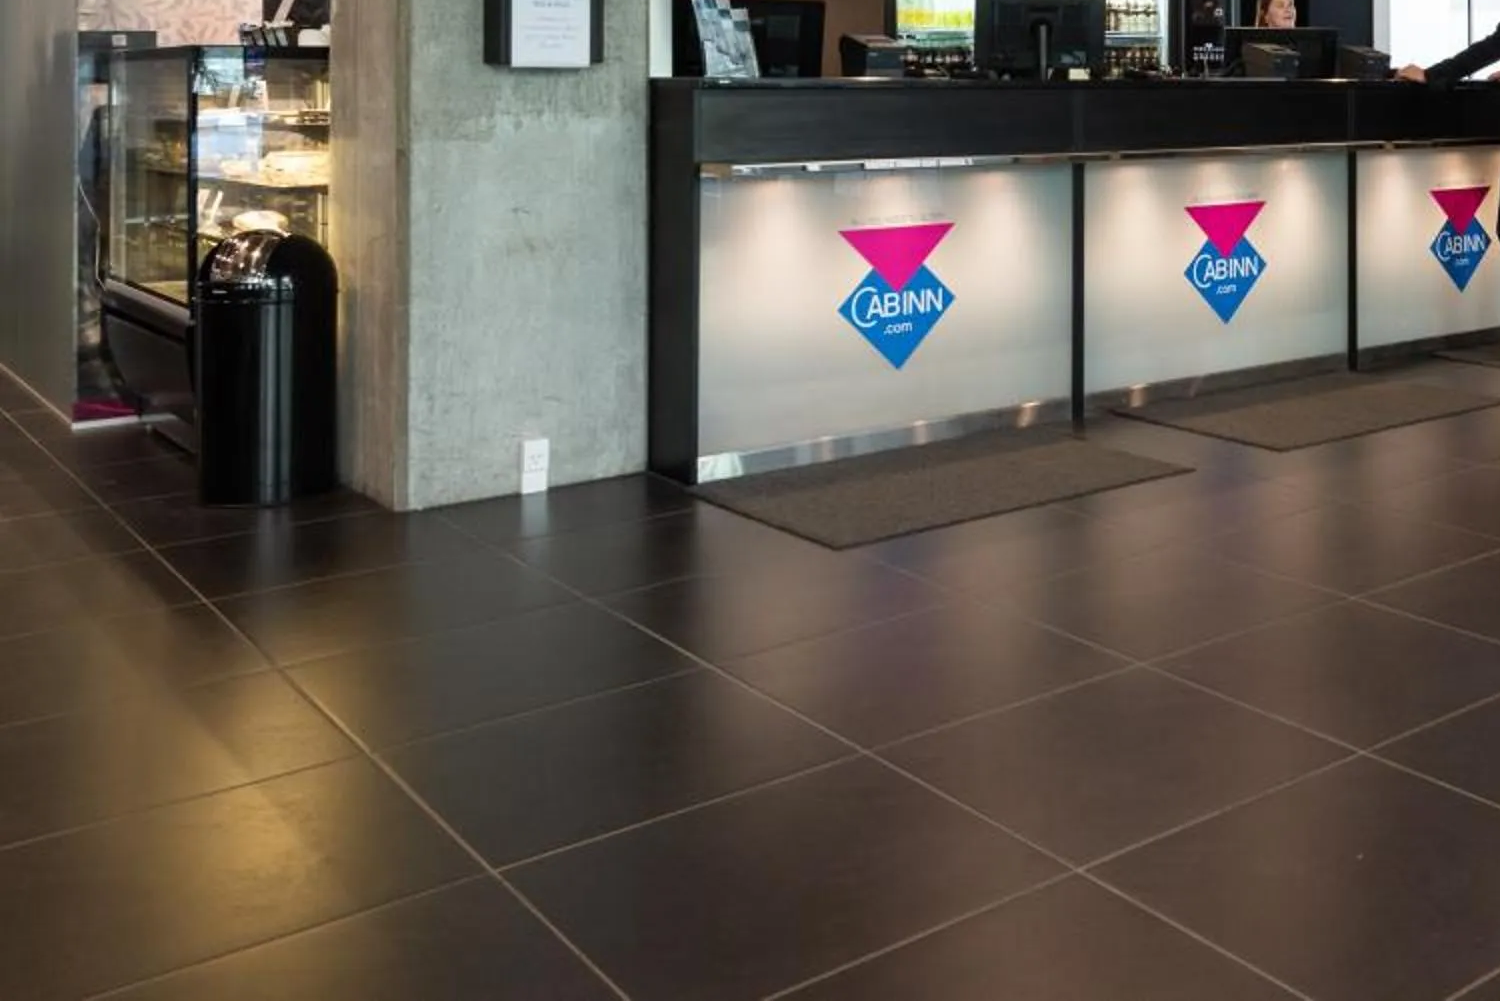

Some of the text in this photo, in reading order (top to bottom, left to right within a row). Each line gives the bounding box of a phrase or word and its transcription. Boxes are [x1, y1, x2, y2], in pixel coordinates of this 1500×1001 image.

[1436, 231, 1485, 262] CABINN
[1193, 254, 1259, 288] CABINN
[851, 286, 943, 328] CABINN
[883, 322, 913, 335] .com
